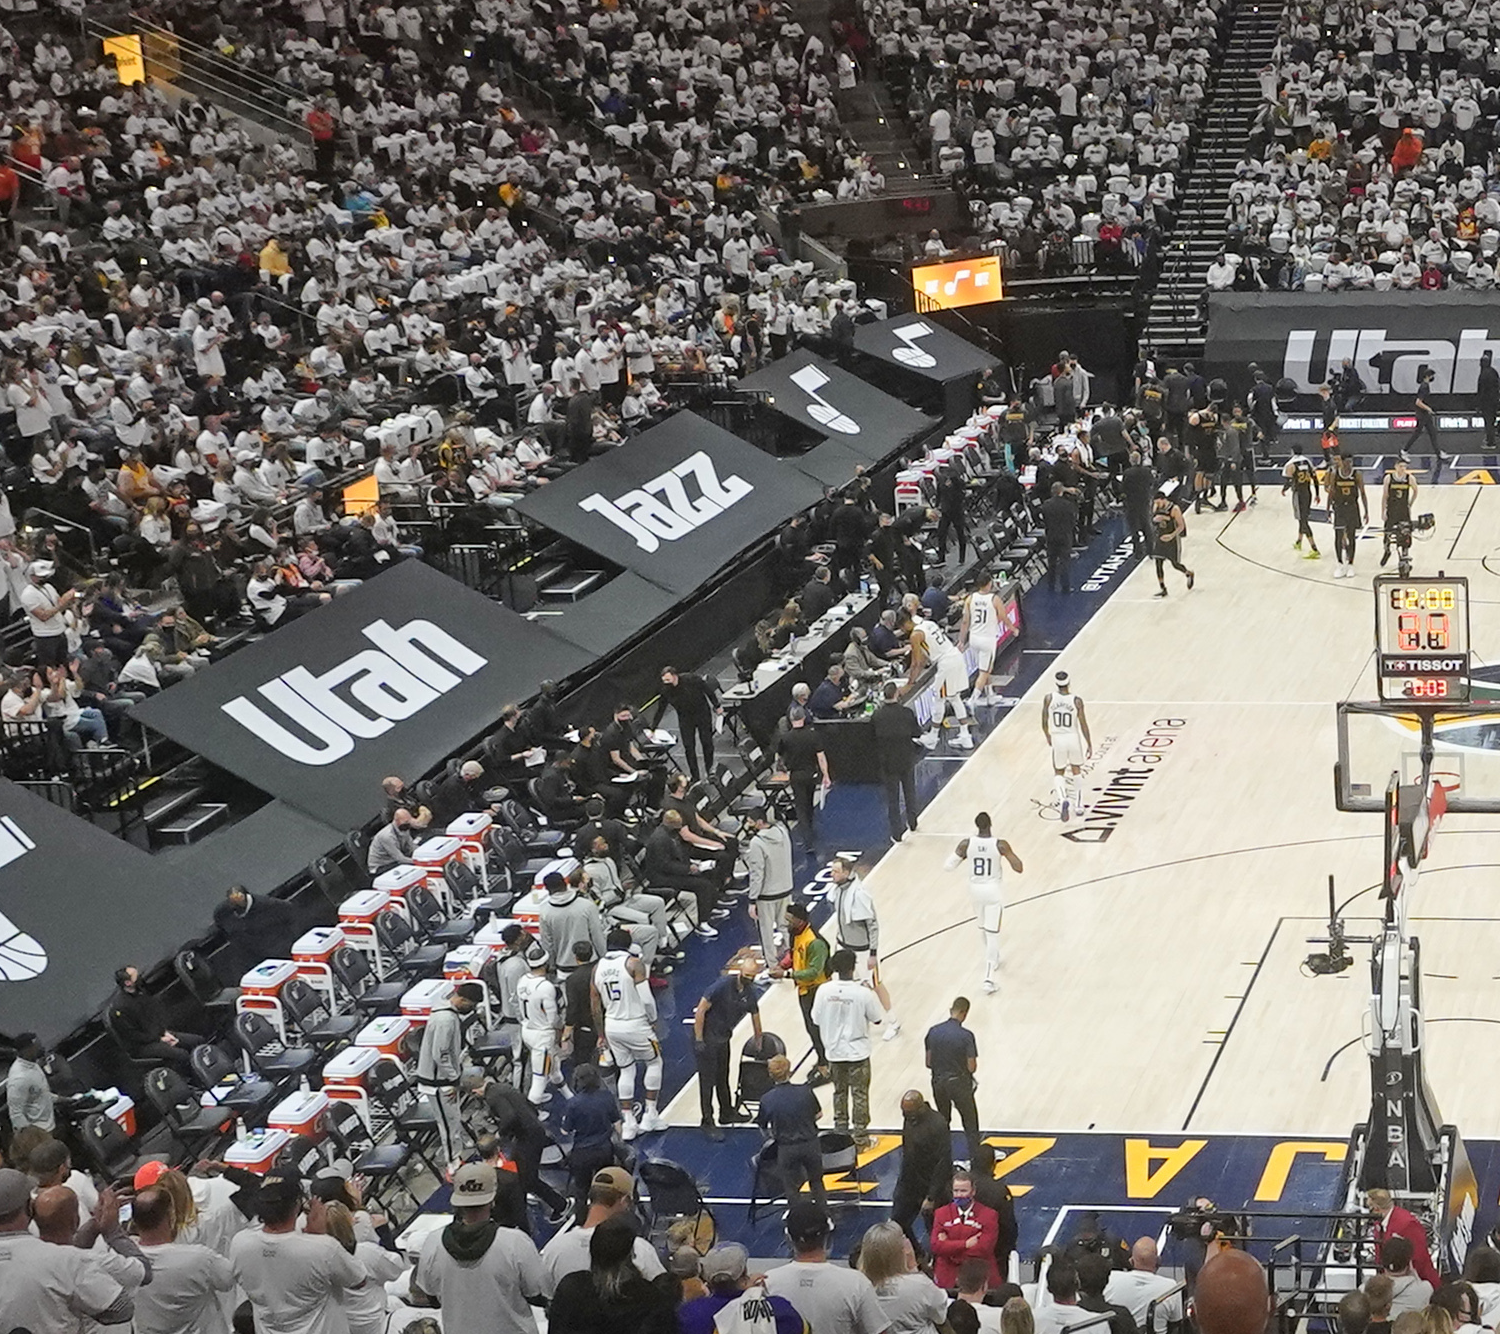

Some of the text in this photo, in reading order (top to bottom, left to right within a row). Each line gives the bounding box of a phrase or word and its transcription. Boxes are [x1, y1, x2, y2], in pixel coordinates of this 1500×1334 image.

[576, 450, 755, 554] Jazz
[974, 608, 988, 625] 31
[1409, 659, 1464, 672] TISSOT
[219, 617, 490, 766] Utah
[1052, 712, 1073, 728] 00
[1126, 717, 1187, 767] arena
[1081, 767, 1155, 830] vivint
[974, 858, 993, 877] 81
[604, 981, 621, 1001] 15
[1386, 1099, 1405, 1169] NBA
